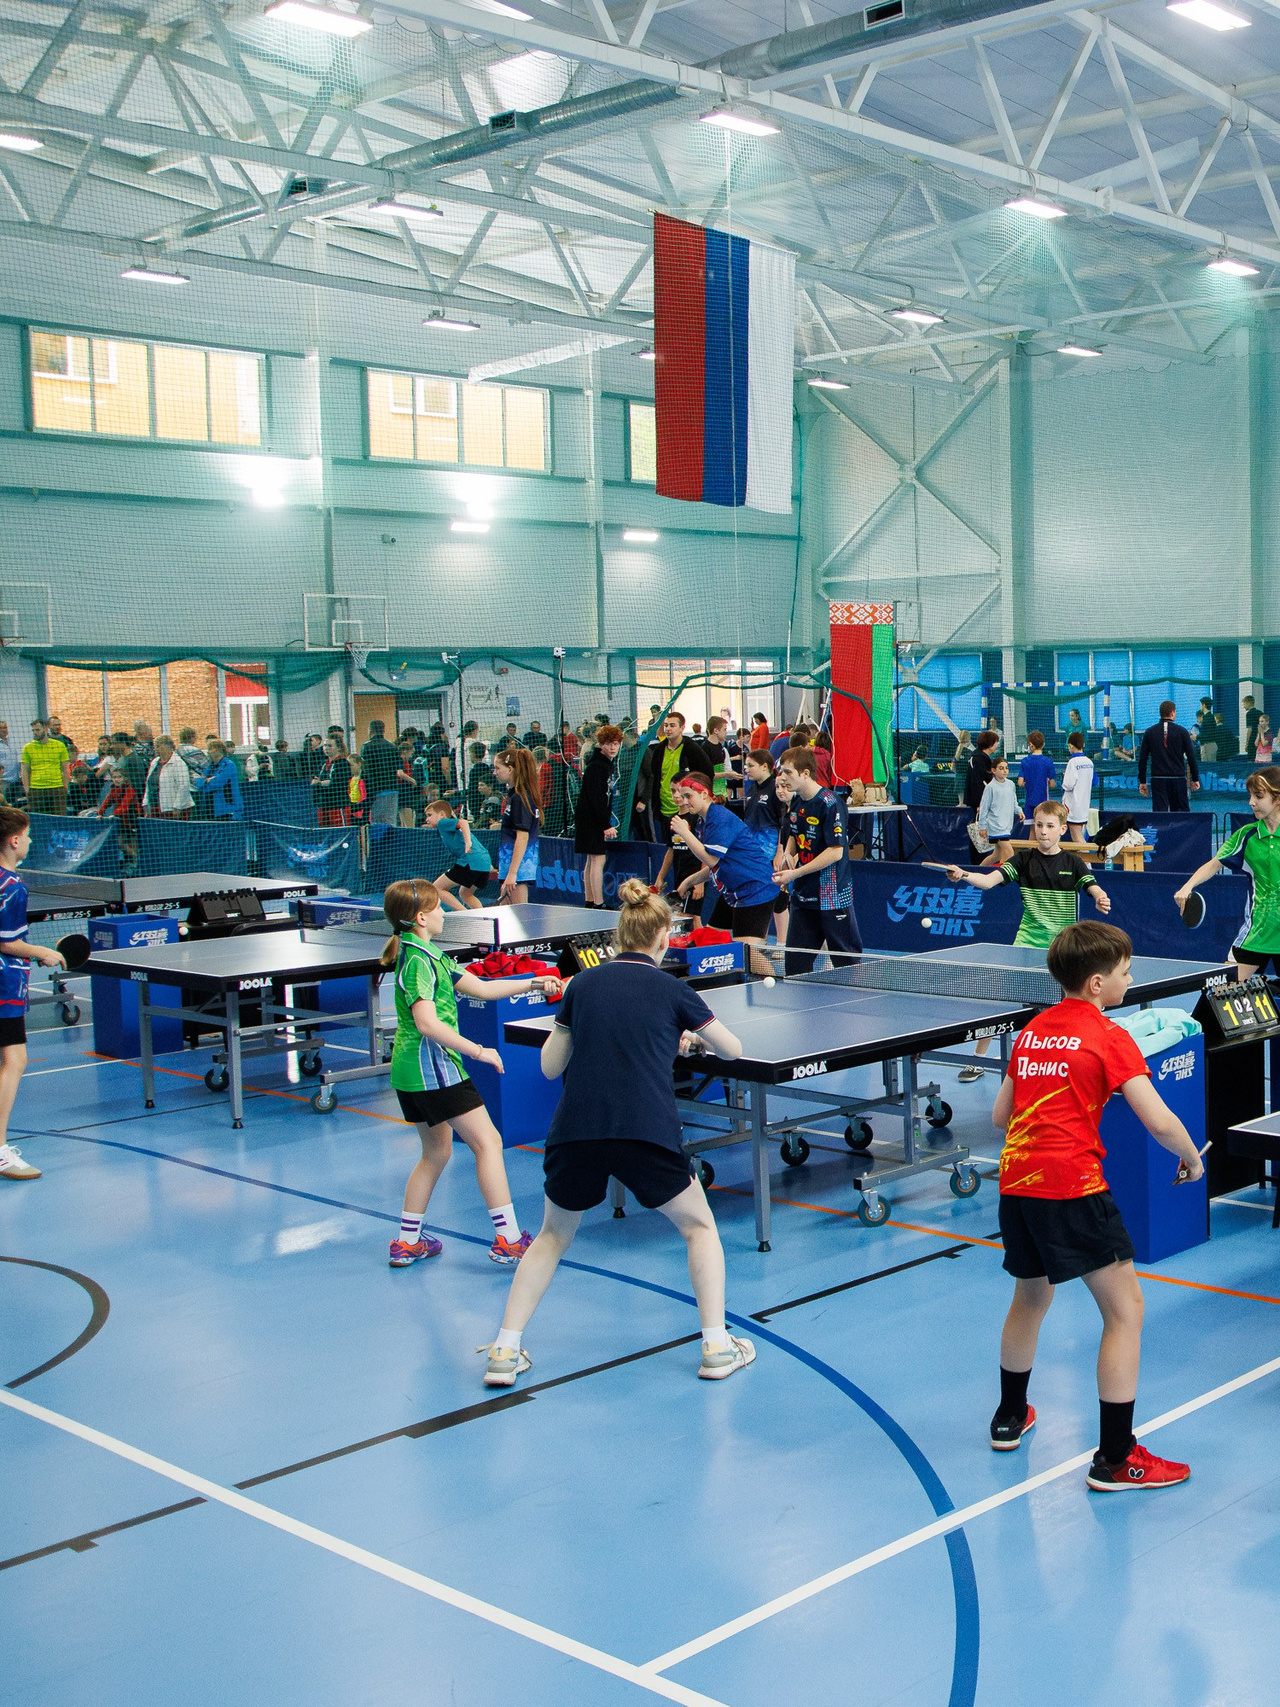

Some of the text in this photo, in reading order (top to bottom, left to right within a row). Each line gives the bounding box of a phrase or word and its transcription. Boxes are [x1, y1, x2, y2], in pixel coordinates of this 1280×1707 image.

[283, 889, 306, 899] JOOLA
[887, 885, 984, 922] 红双喜
[930, 917, 980, 937] DHS
[239, 977, 273, 990] JOOLA
[1205, 974, 1228, 987] JOOLA
[1243, 998, 1253, 1012] 2
[1255, 994, 1276, 1020] 11
[996, 1021, 1014, 1035] 25-S
[1017, 1031, 1082, 1051] Лысов
[793, 1060, 828, 1079] JOOLA
[1017, 1056, 1069, 1079] Денис
[1175, 1067, 1193, 1081] DHS
